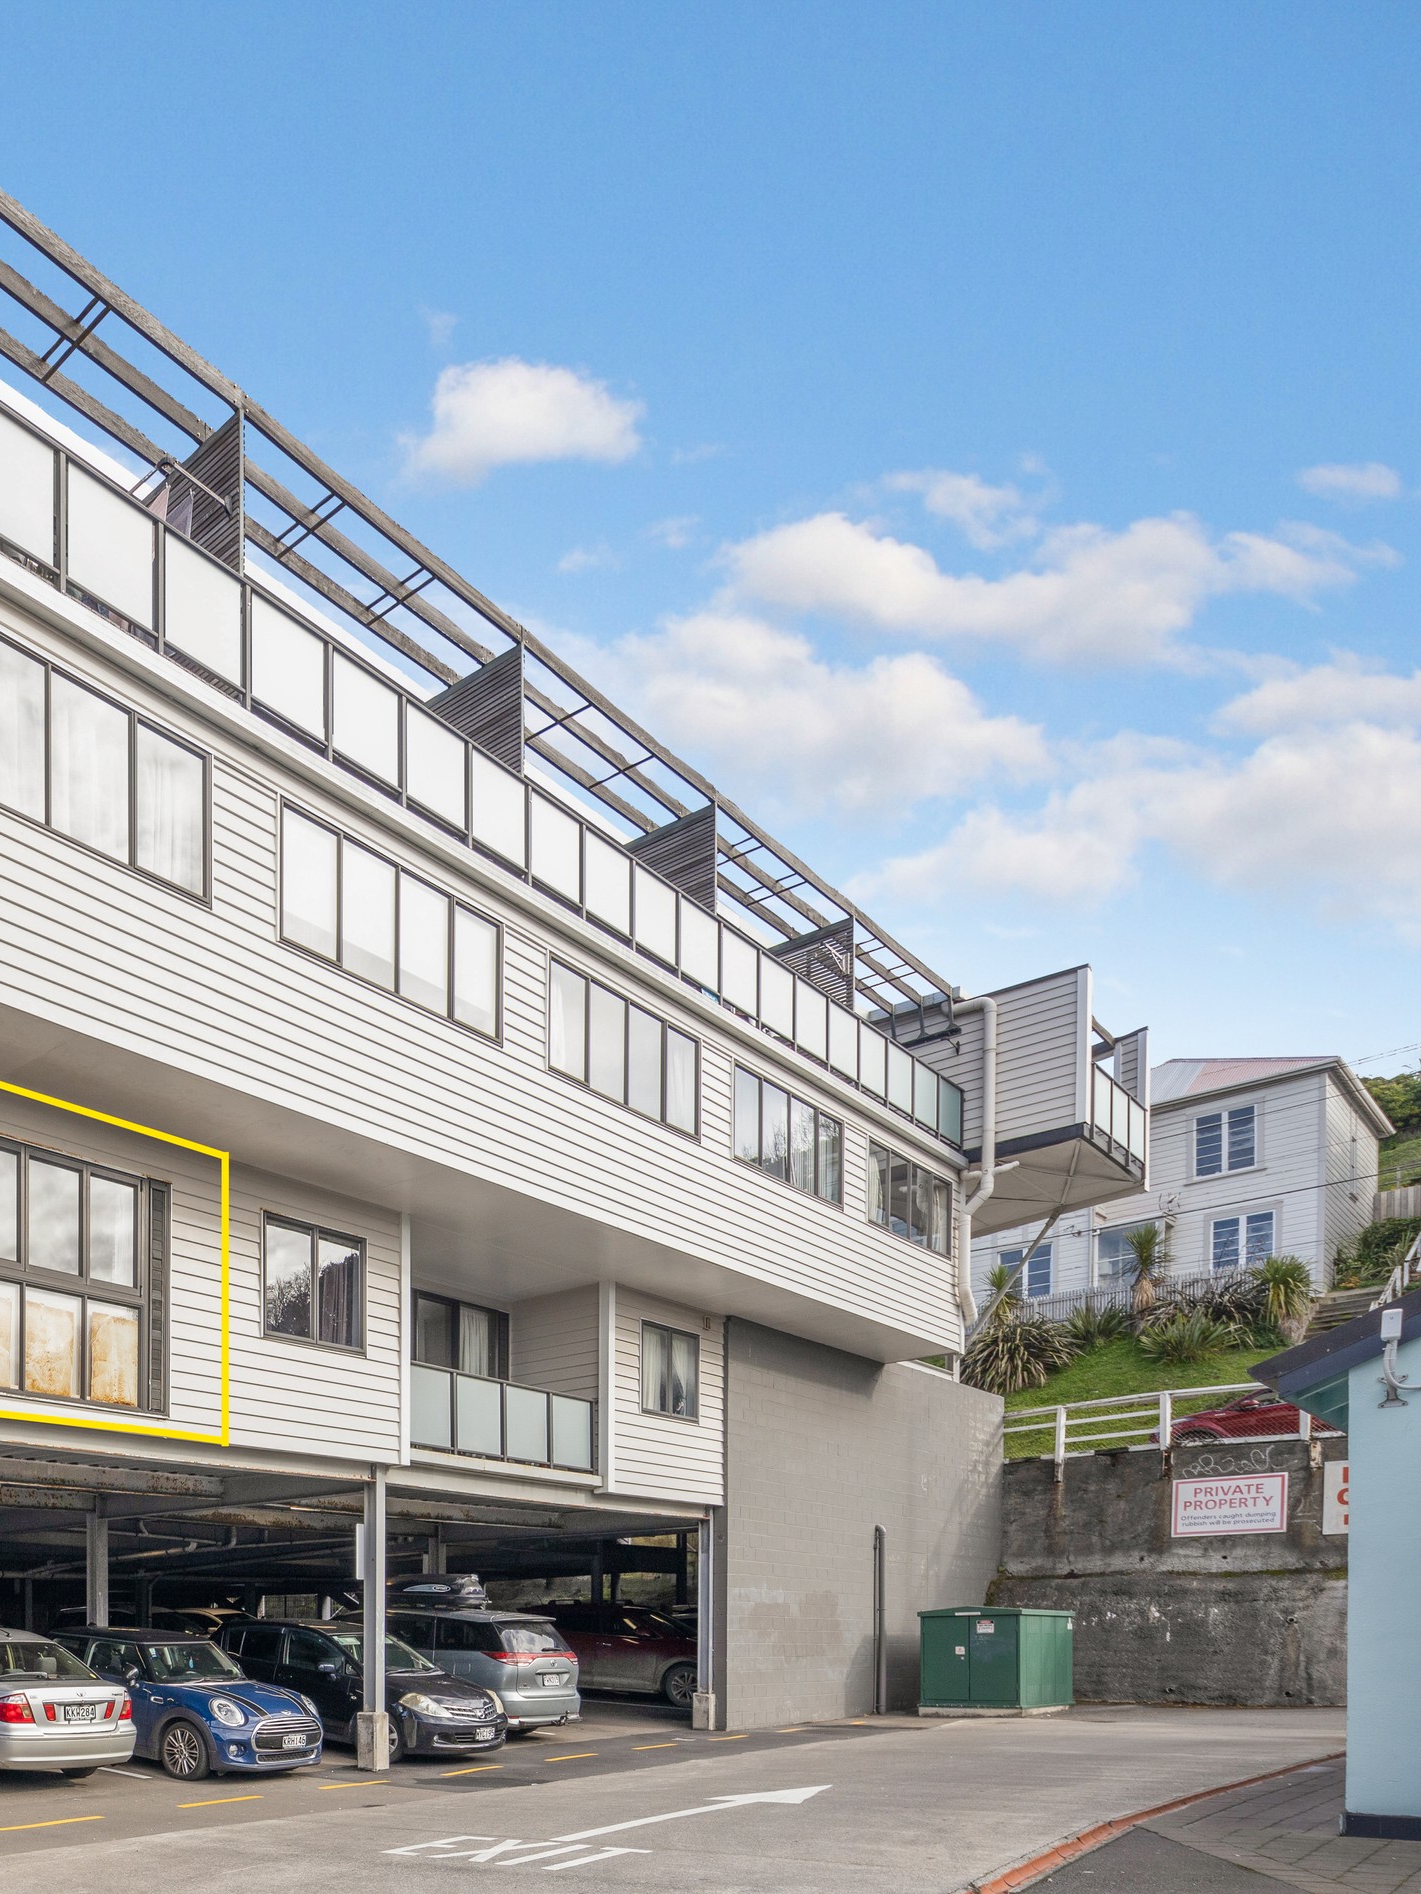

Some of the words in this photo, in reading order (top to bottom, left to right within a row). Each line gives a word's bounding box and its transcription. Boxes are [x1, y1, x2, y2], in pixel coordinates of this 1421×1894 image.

[1193, 1483, 1265, 1498] PRIVATE
[1183, 1496, 1273, 1511] PROPERTY
[379, 1835, 654, 1871] EXIT
